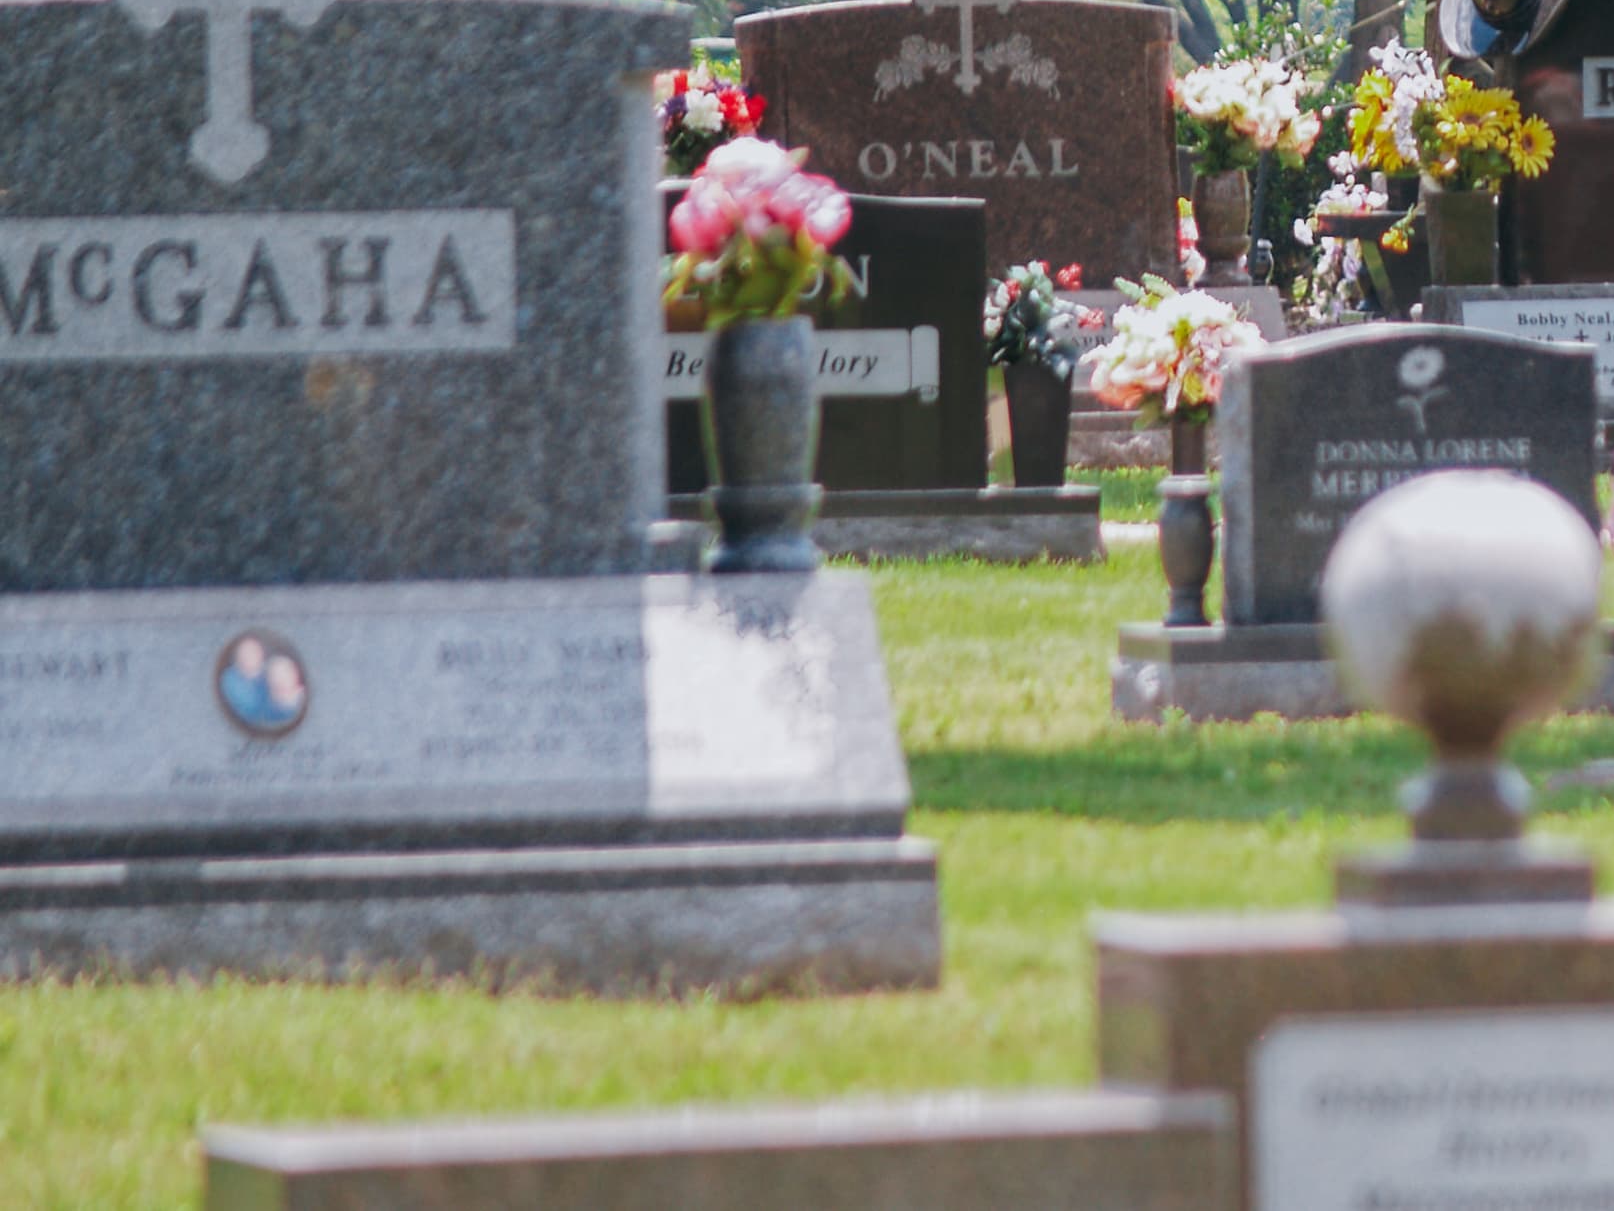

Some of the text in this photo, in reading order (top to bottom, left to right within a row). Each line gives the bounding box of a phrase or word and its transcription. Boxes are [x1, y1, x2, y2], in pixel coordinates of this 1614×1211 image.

[857, 140, 1079, 180] O'NEAL
[1517, 311, 1568, 328] Bobby
[1314, 438, 1532, 464] DONNA LORENE
